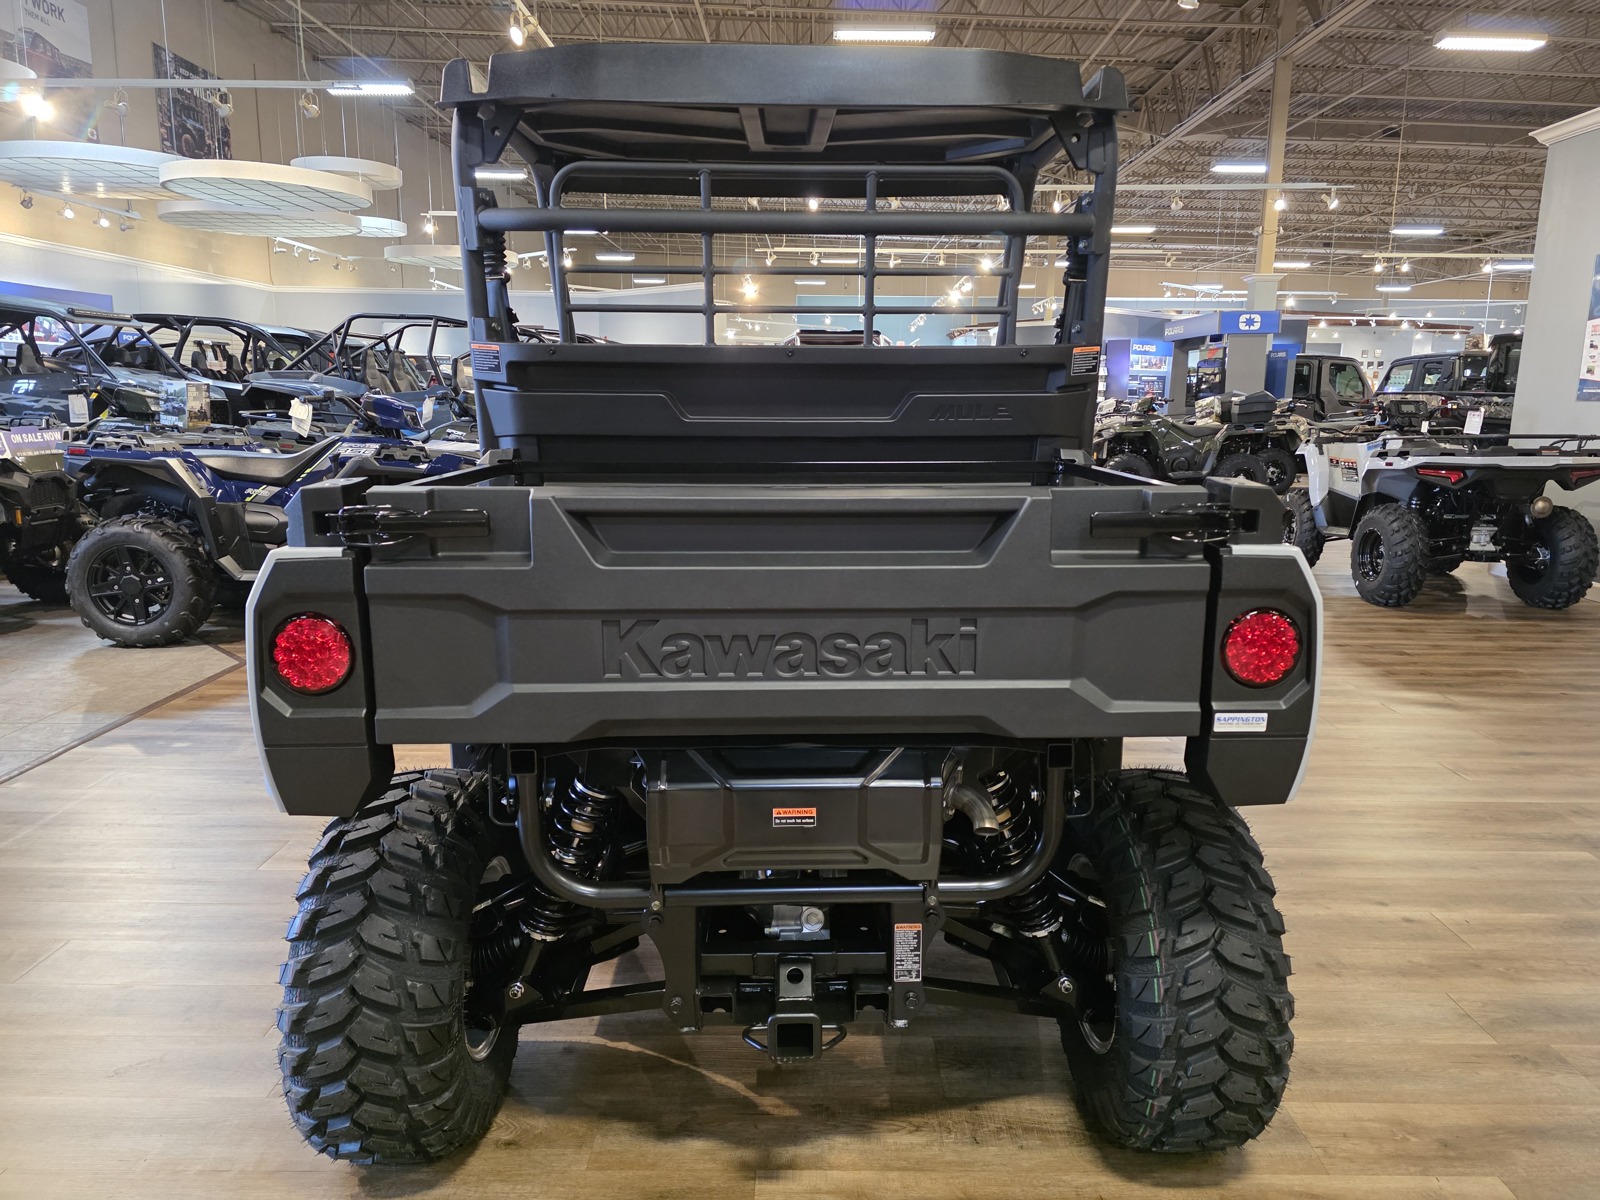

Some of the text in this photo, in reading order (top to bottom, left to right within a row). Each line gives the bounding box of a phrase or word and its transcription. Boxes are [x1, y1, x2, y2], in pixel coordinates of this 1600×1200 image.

[24, 8, 51, 27] THEM ALL
[1164, 325, 1184, 336] POLARIS
[1132, 344, 1156, 352] POLARIS
[928, 404, 1013, 421] MULE
[11, 431, 61, 443] ON SALE NOW
[601, 618, 978, 678] Kawasaki
